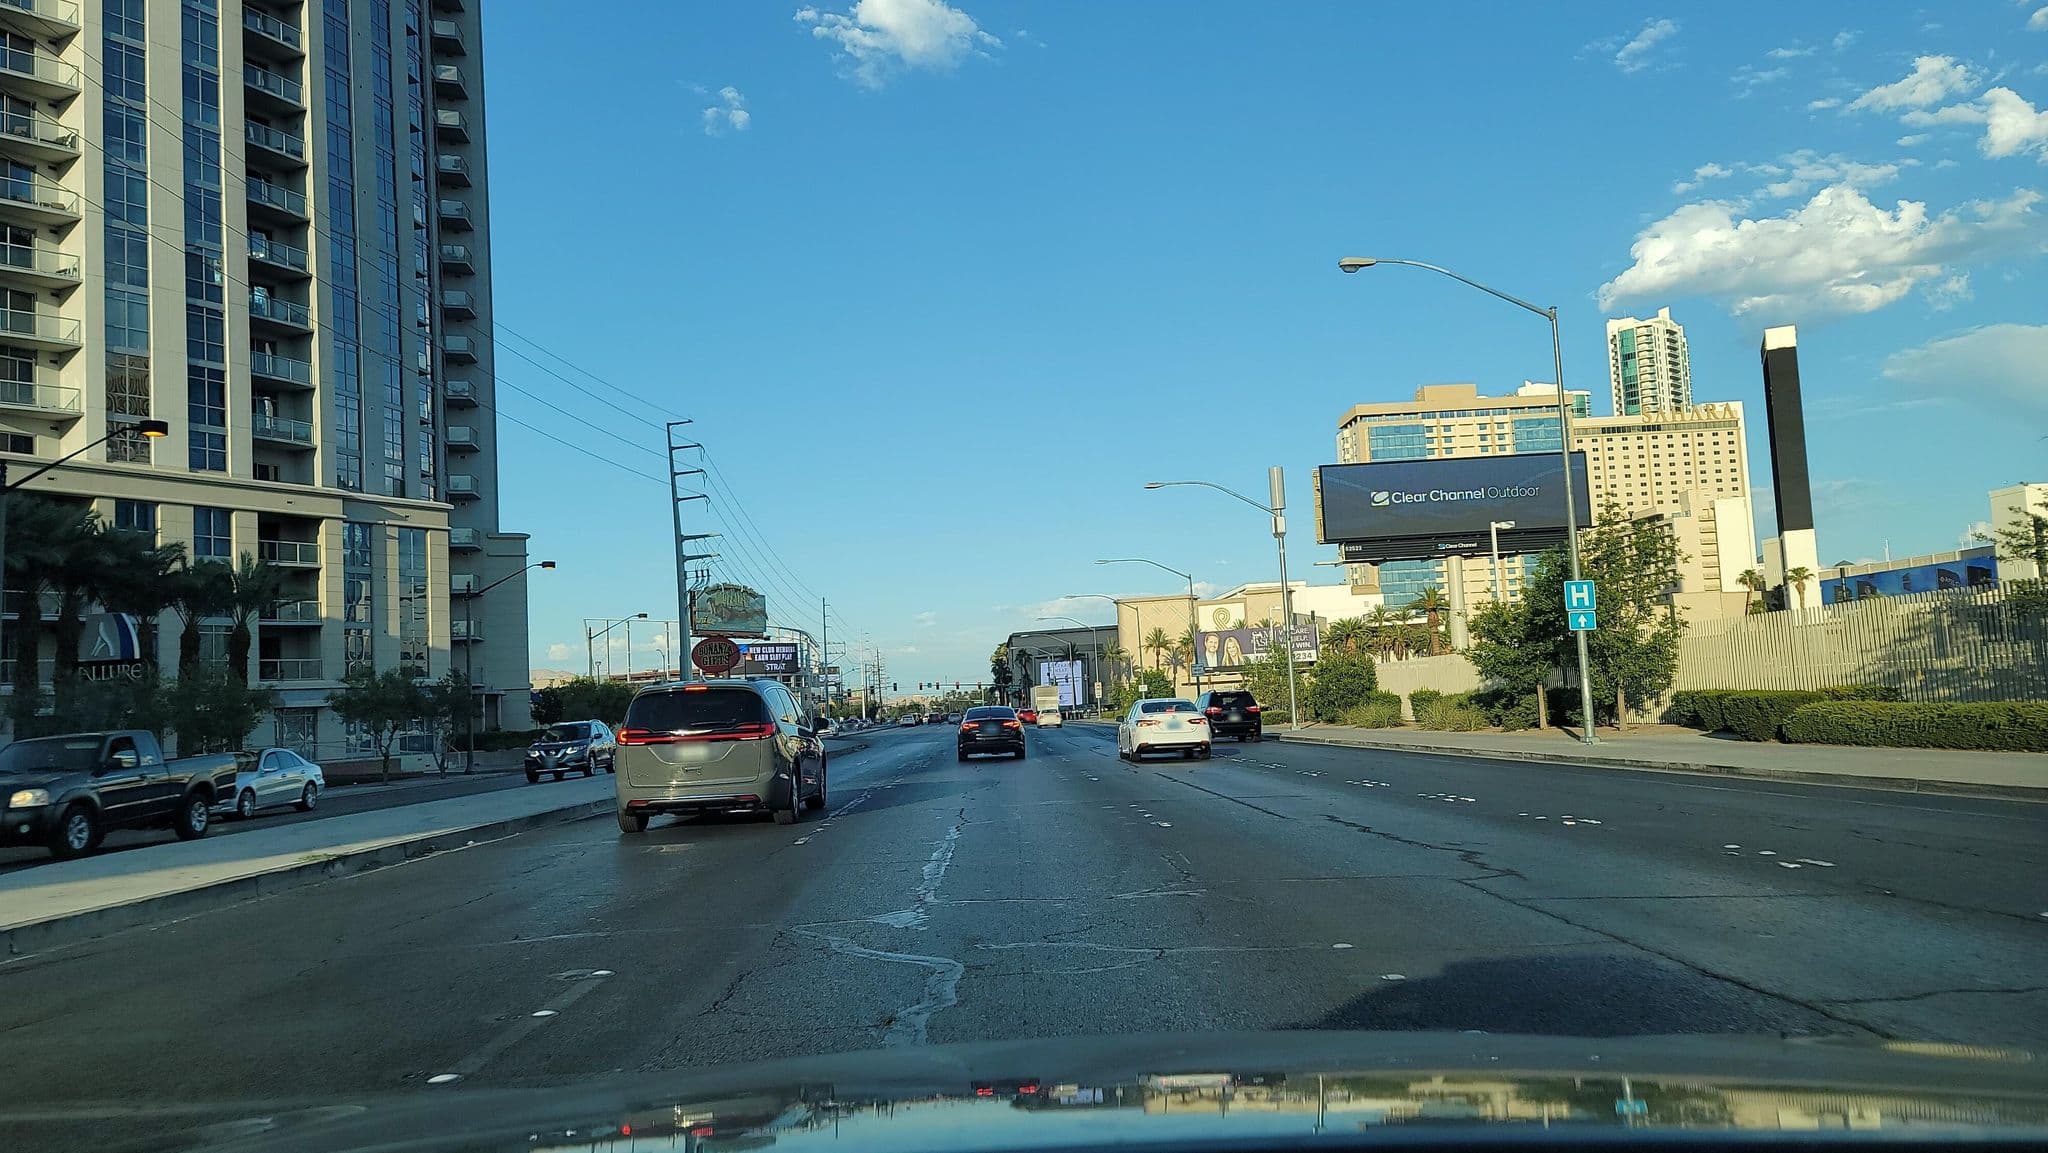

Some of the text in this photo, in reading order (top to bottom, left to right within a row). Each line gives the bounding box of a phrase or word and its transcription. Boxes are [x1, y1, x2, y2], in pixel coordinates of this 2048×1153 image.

[1641, 402, 1738, 423] SAHARA
[1391, 485, 1539, 504] Clear Channel Outdoor
[1571, 584, 1589, 607] H
[698, 642, 733, 656] BONANZA
[703, 655, 729, 666] GIFTS
[765, 663, 786, 671] STRAT
[79, 663, 142, 681] ALLURE
